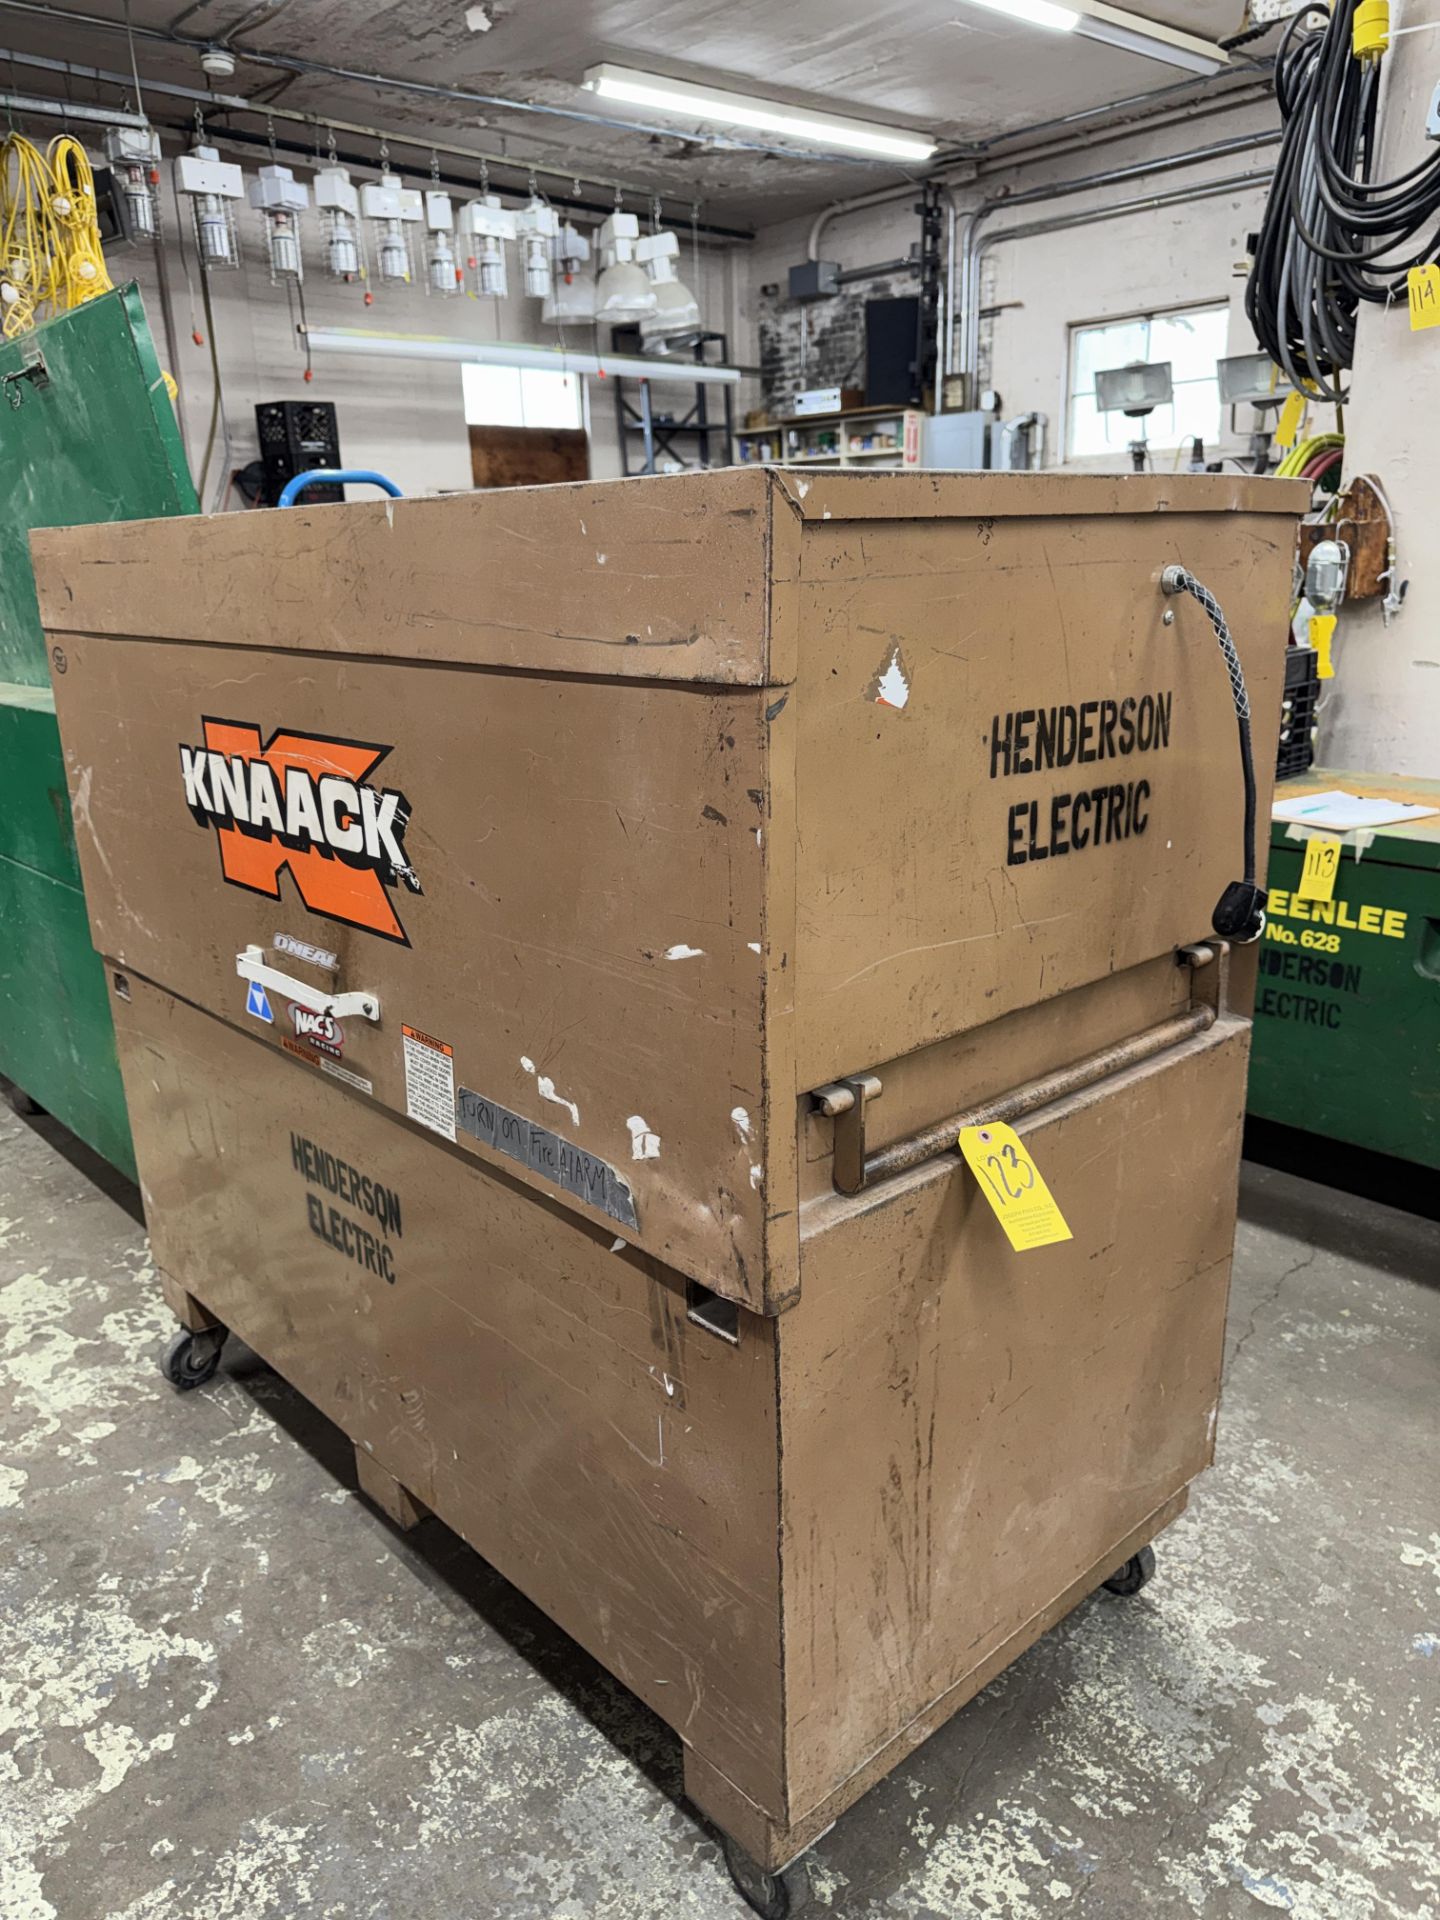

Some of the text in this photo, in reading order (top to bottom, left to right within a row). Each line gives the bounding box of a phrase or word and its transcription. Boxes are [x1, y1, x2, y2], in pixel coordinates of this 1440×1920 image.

[1411, 279, 1436, 313] 114
[990, 691, 1172, 778] HENDERSON
[180, 746, 410, 870] KNAACK
[1007, 779, 1150, 866] ELECTRIC
[1307, 848, 1335, 878] 113
[1265, 922, 1341, 953] No. 628
[415, 1032, 445, 1054] WARNING
[290, 1131, 403, 1239] HENDERSON
[977, 1144, 1034, 1206] 123
[306, 1191, 396, 1285] ELECTRIC
